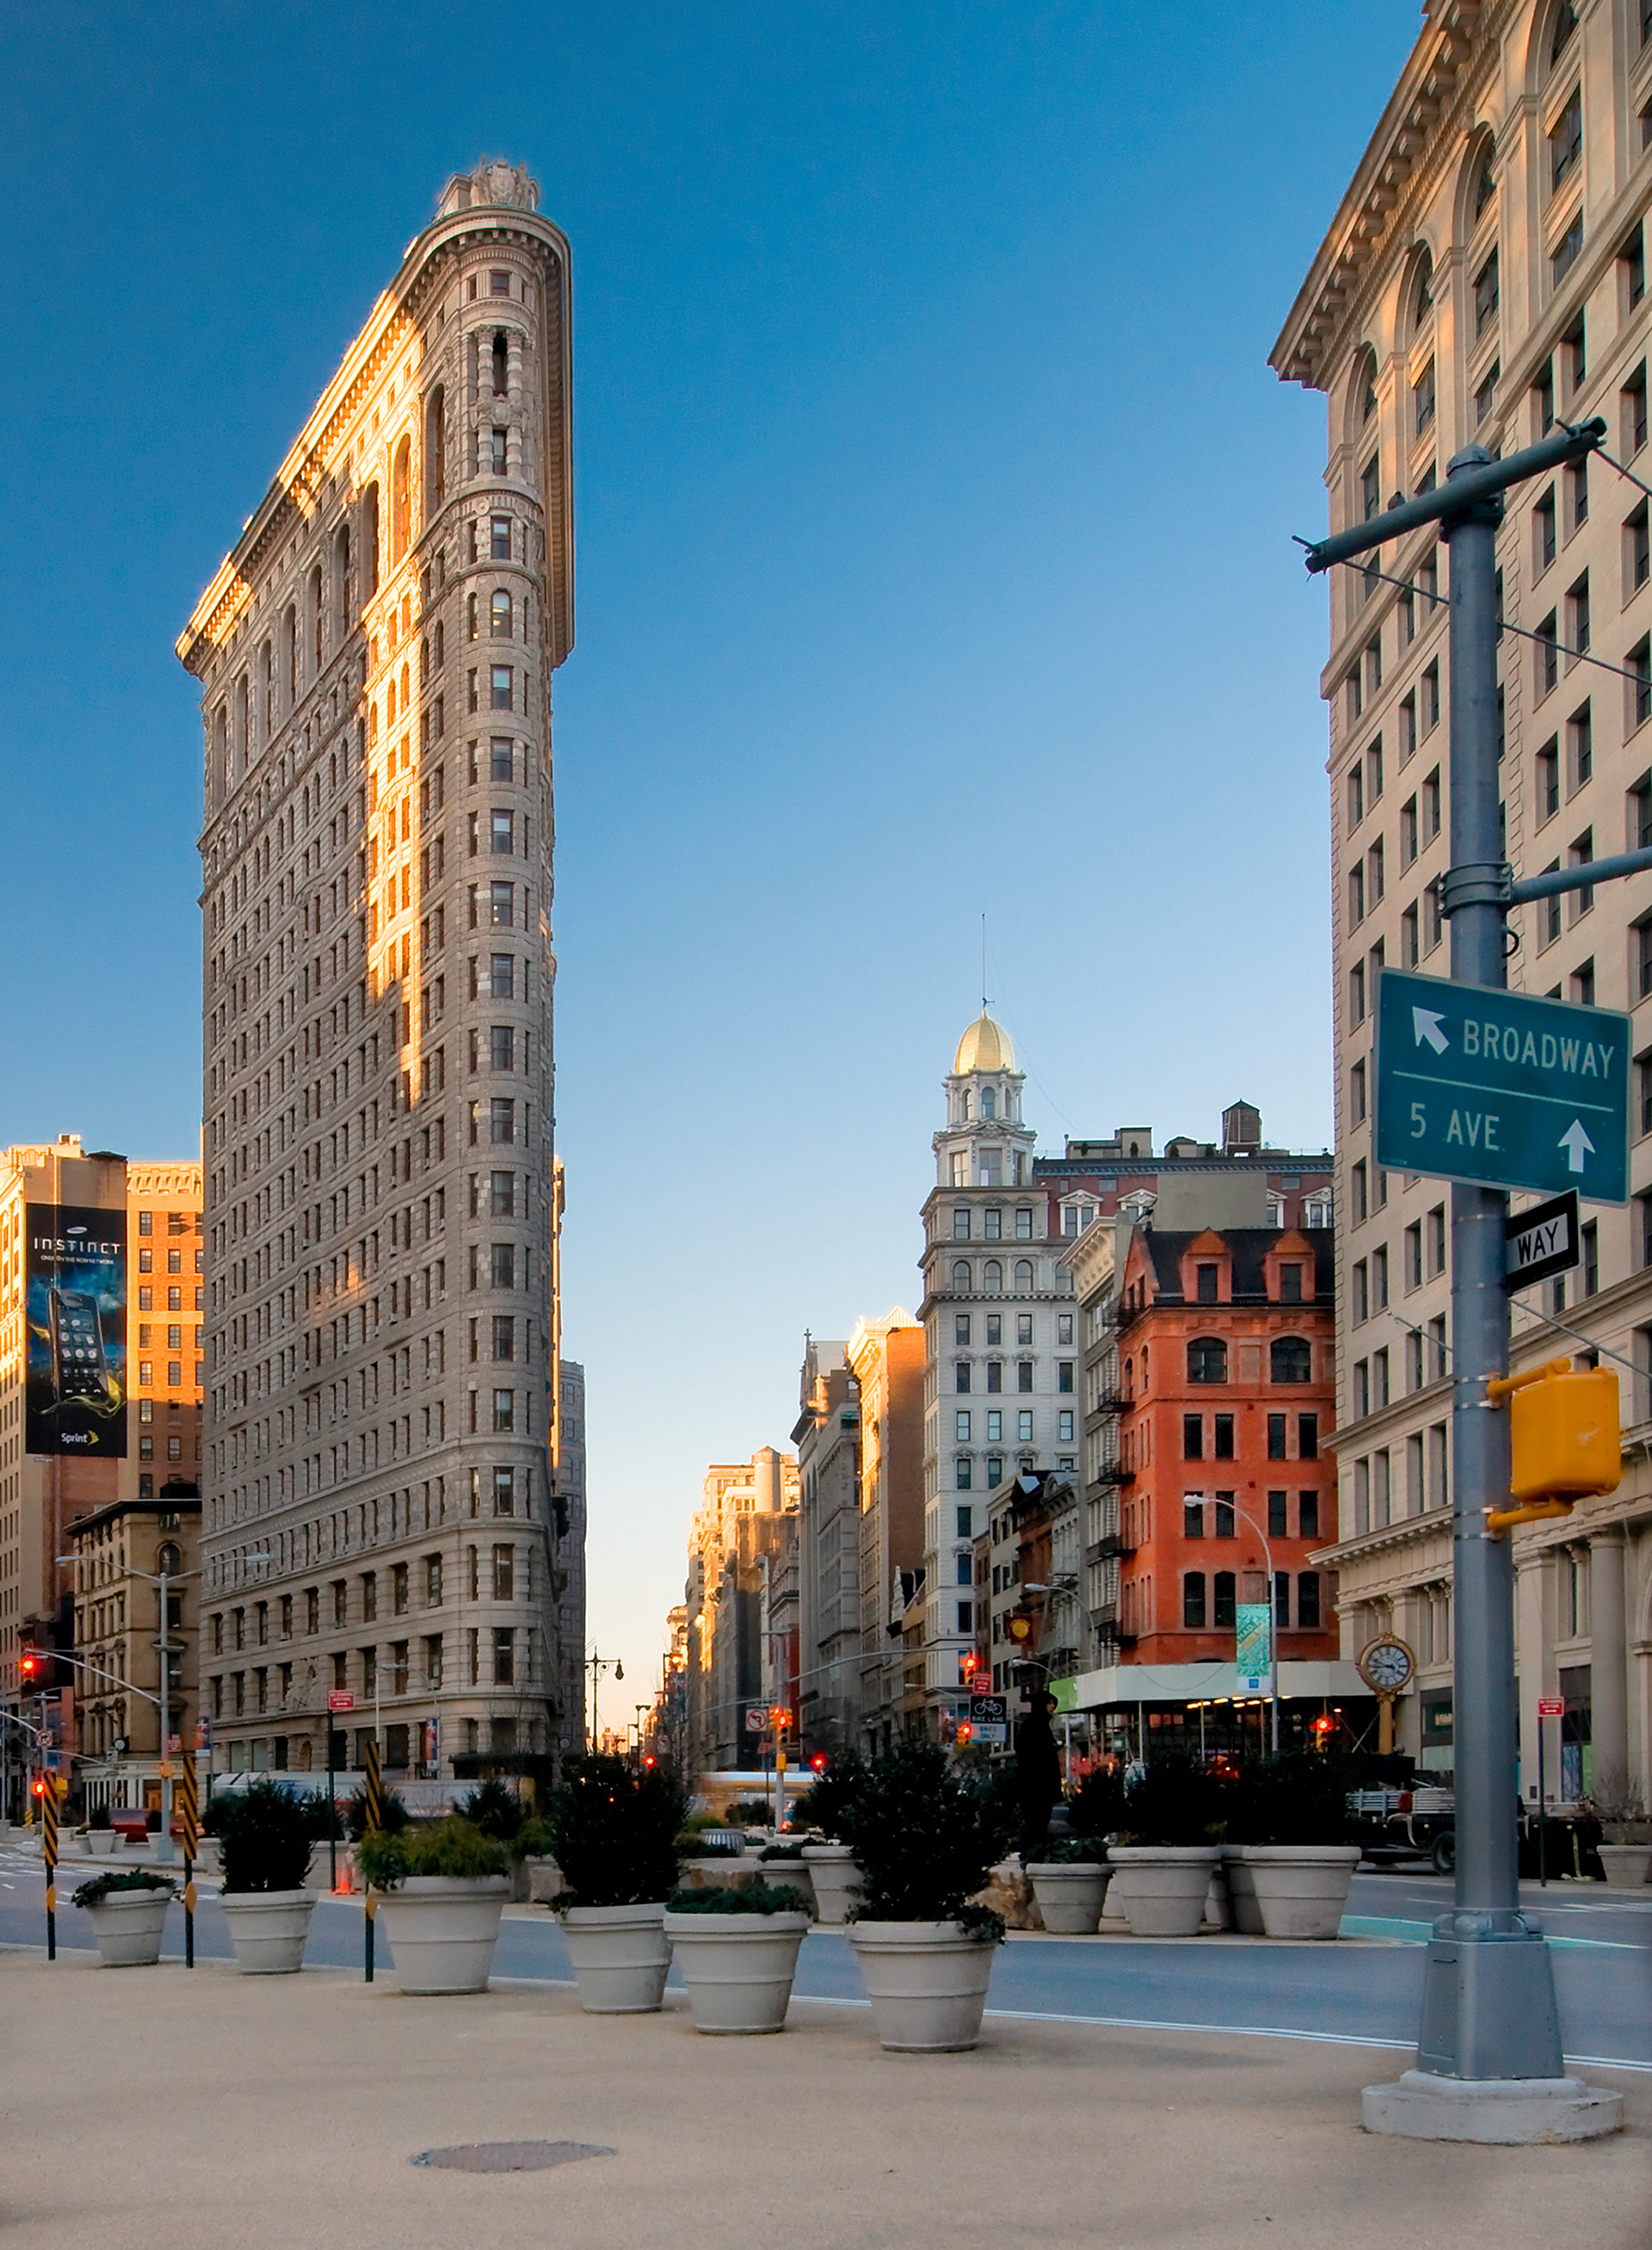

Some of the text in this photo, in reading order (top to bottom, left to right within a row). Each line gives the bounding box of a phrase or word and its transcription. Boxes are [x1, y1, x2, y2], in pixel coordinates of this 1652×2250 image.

[1464, 1019, 1615, 1080] BROADWAY
[1410, 1102, 1500, 1151] 5 AVE
[34, 1237, 120, 1254] INSTINCT
[1518, 1221, 1558, 1266] WAY
[61, 1432, 89, 1445] Sprint
